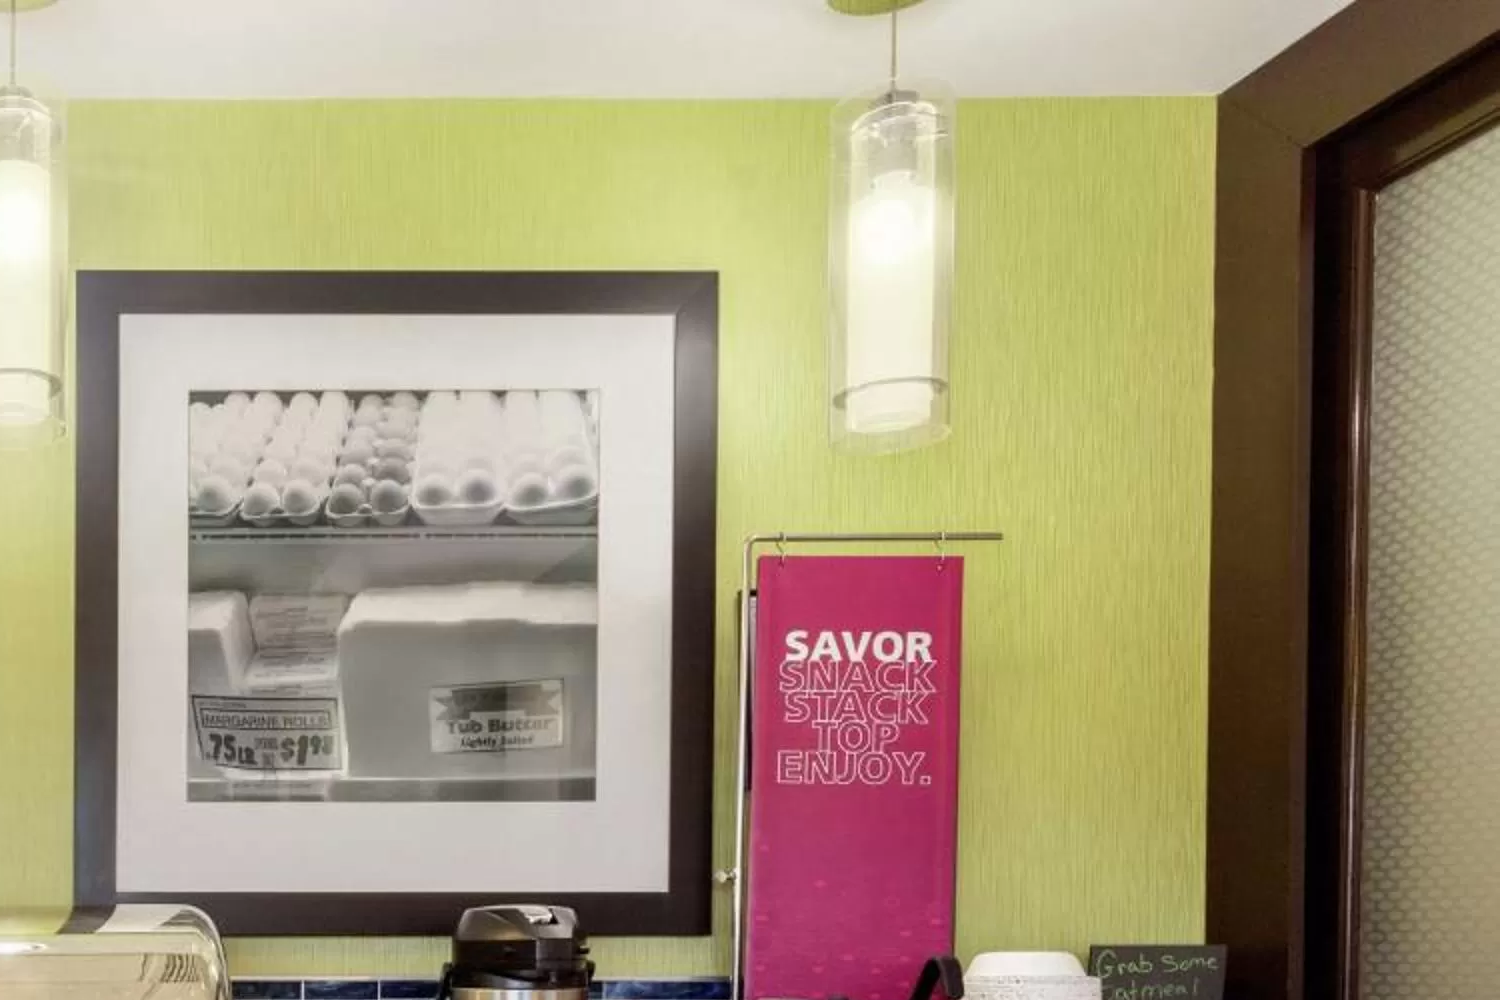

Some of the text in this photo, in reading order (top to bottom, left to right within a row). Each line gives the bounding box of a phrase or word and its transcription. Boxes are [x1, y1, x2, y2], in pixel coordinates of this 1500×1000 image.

[784, 629, 933, 662] SAVOR
[779, 660, 937, 693] SNACK
[784, 690, 929, 724] STACK
[812, 720, 900, 754] TOP
[777, 750, 932, 785] ENJOY.
[1096, 949, 1153, 979] Grab
